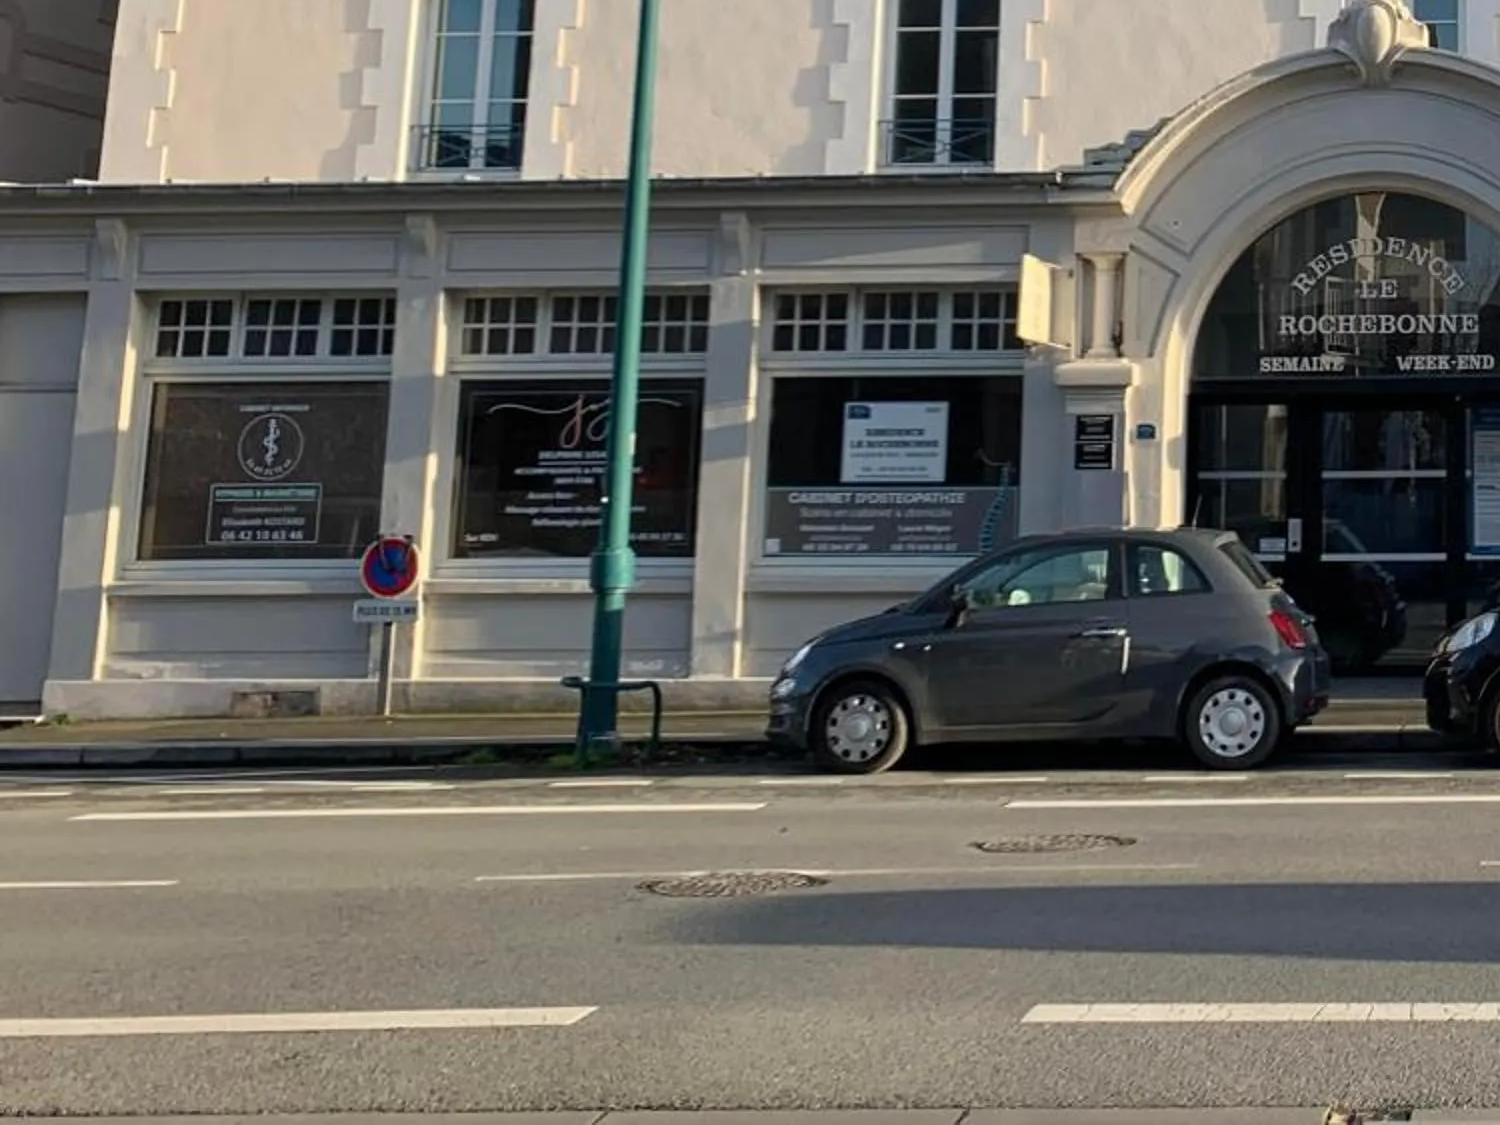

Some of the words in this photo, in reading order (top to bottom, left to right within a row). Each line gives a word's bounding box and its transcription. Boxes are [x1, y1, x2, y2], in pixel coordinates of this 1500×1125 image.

[1291, 236, 1465, 295] RESIDENCE
[1358, 279, 1398, 299] LE
[1279, 315, 1479, 335] ROCHEBONNE
[1260, 356, 1345, 373] SEMAINE
[1396, 355, 1495, 372] WEEK-END
[788, 492, 852, 503] CABINET
